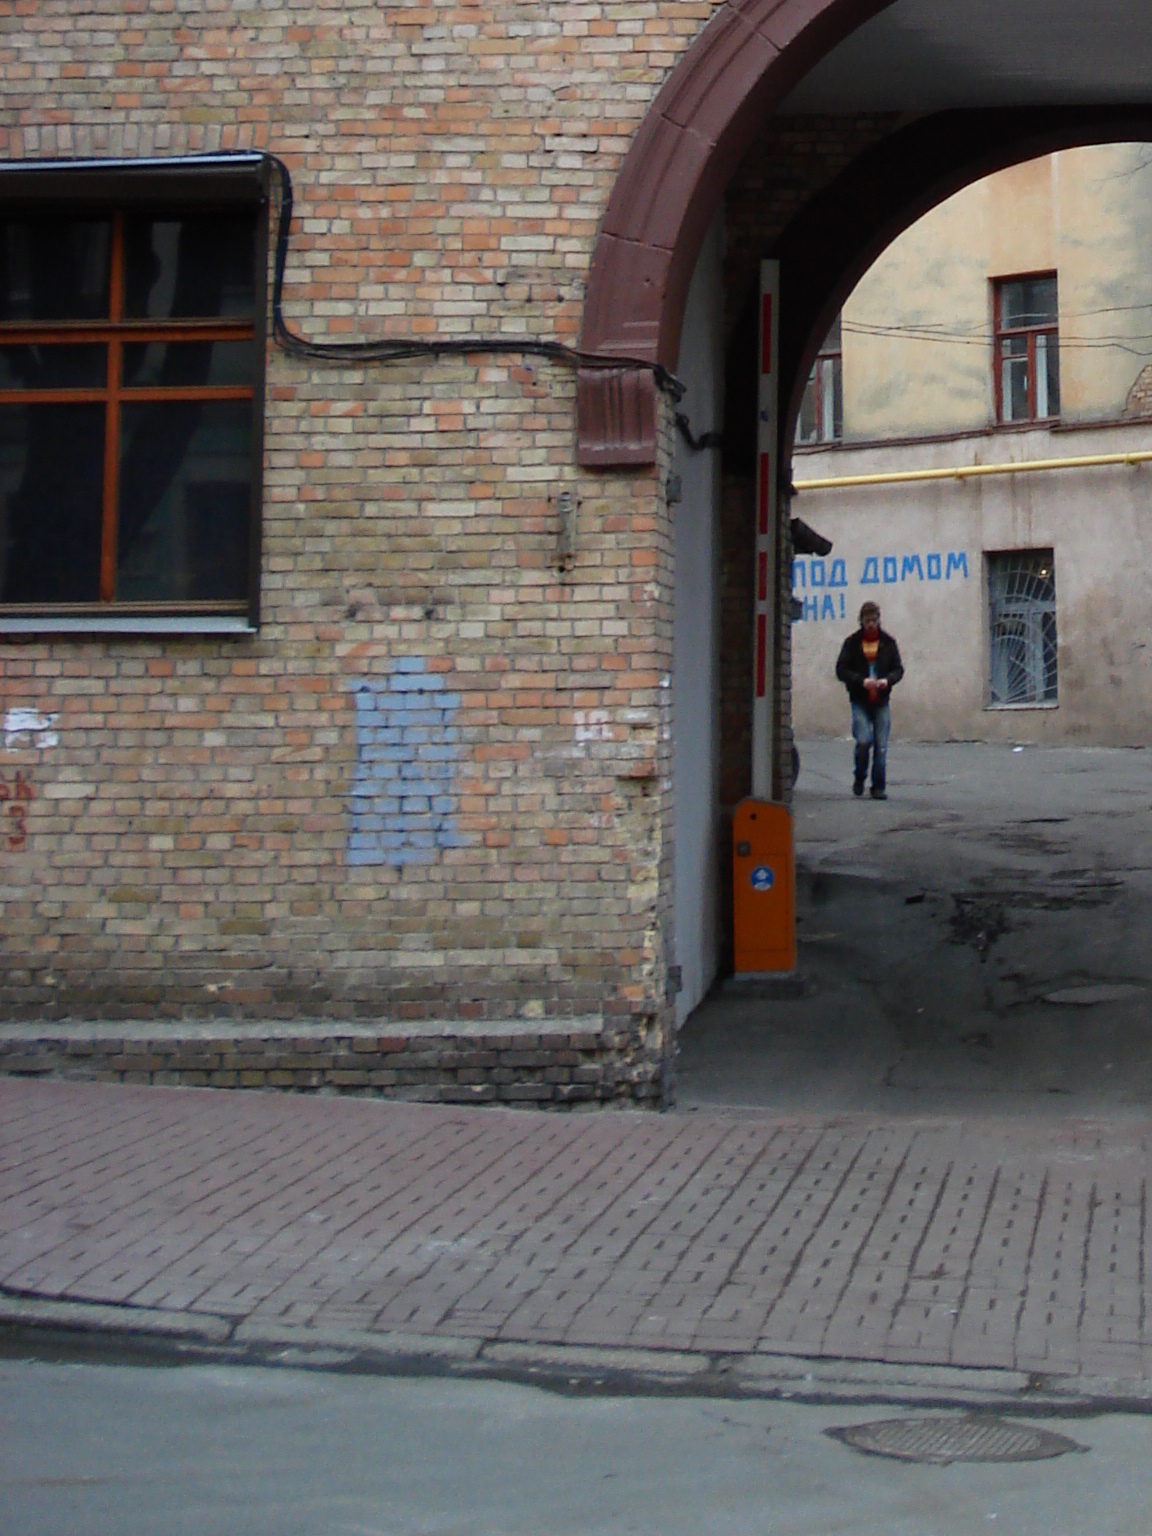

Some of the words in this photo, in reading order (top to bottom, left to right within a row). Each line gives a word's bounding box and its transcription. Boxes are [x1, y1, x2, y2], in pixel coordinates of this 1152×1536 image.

[791, 558, 848, 589] ПОД
[860, 551, 969, 585] ДОМОМ
[792, 593, 845, 623] НА!
